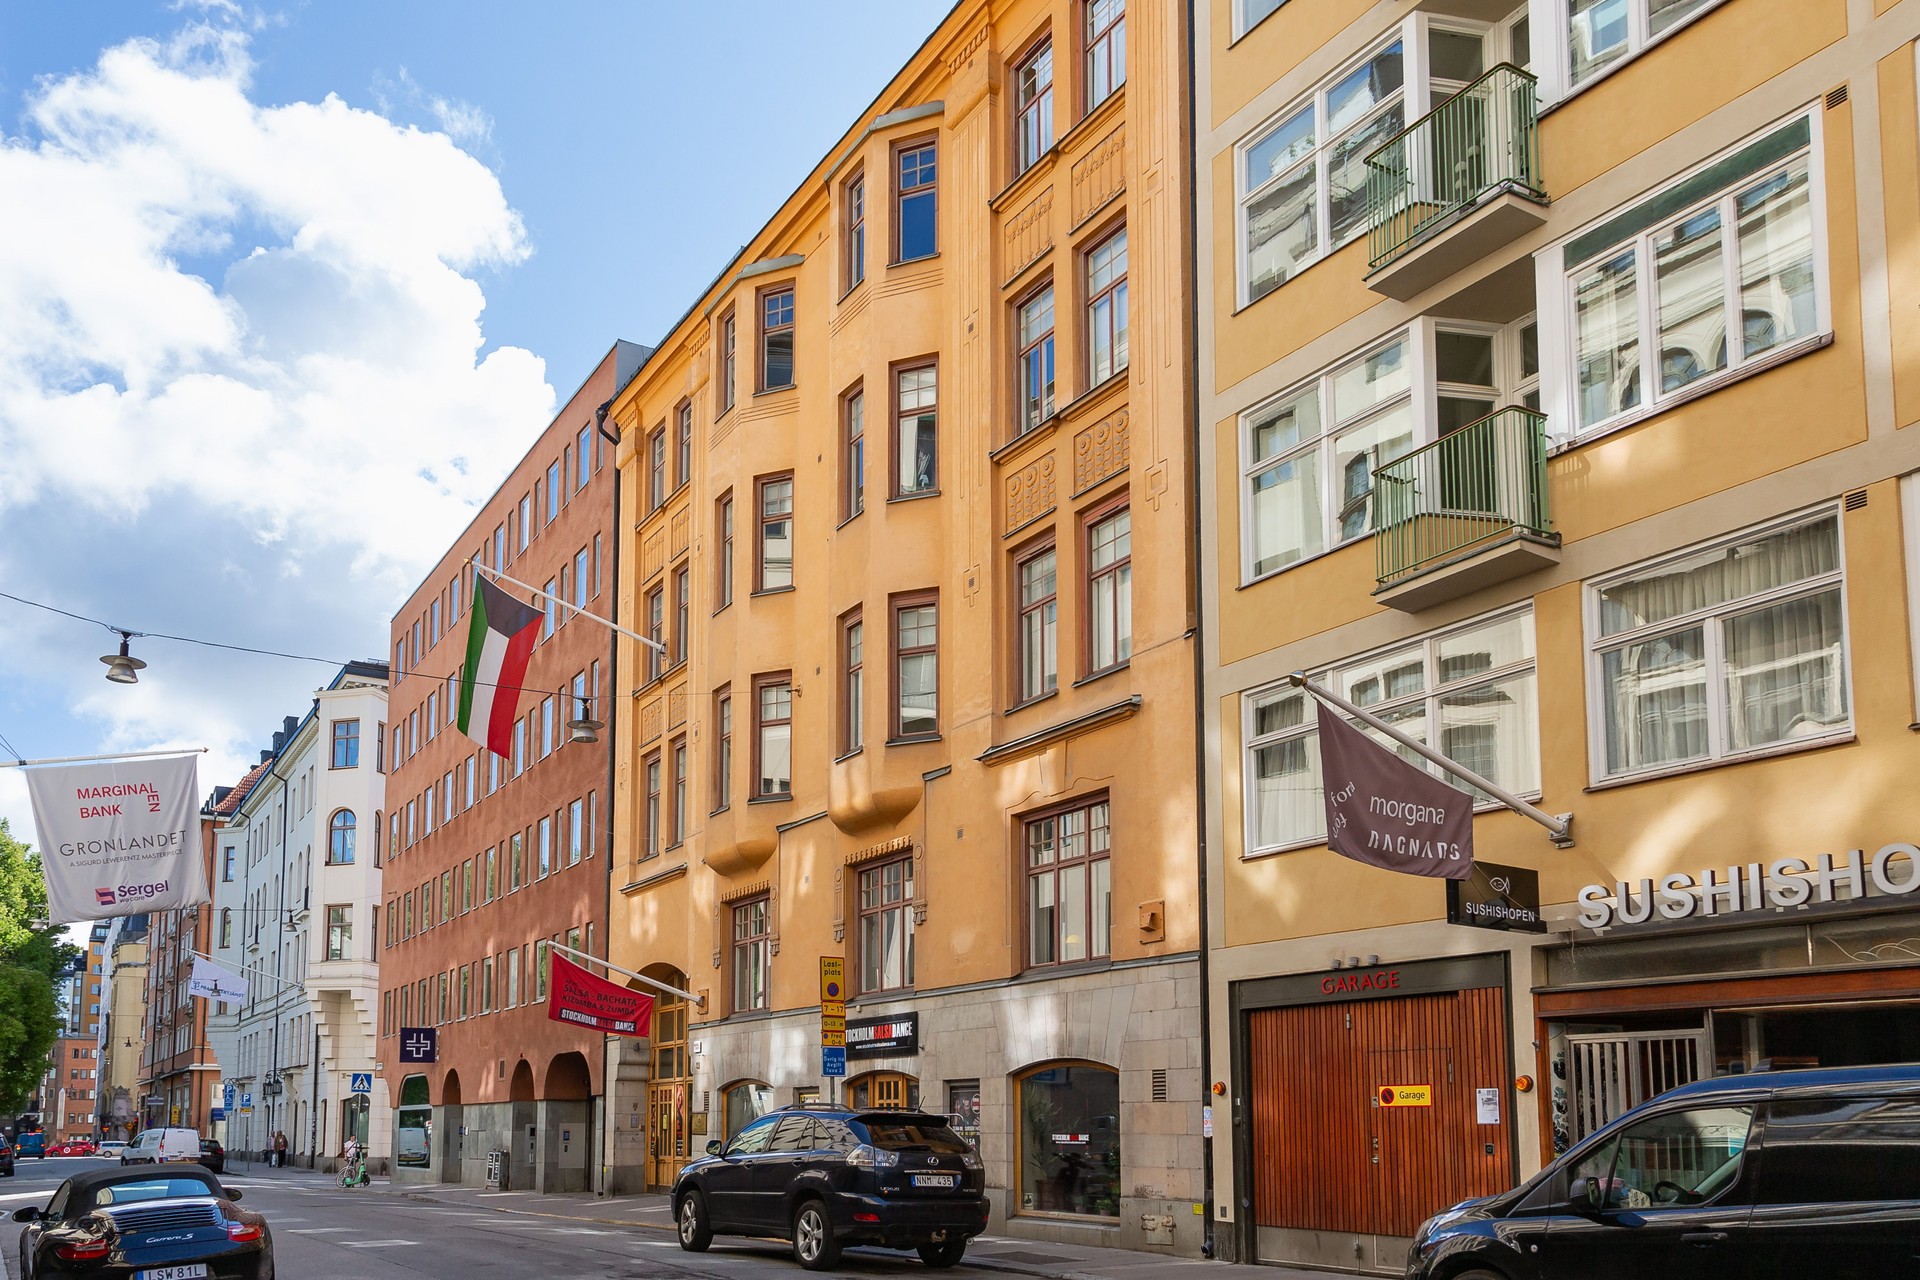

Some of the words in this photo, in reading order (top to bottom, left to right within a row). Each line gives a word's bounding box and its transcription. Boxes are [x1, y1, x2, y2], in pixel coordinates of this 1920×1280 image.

[80, 804, 122, 818] BANK
[1369, 795, 1445, 826] morgana
[60, 830, 186, 856] GRÖNLANDET
[76, 859, 101, 867] SIGURD
[103, 854, 140, 864] LEWERENTZ
[142, 849, 183, 860] MASTERPIECE
[118, 880, 169, 897] Sergel
[1577, 842, 1920, 929] SUSHISHO
[1466, 902, 1535, 922] SUSHISHOPEN
[1321, 971, 1399, 994] GARAGE
[564, 984, 589, 997] SALSA
[596, 994, 637, 1007] BACHATA
[606, 1006, 635, 1016] ZUMBA
[243, 1094, 250, 1102] P
[1399, 1091, 1425, 1100] Garage
[916, 1176, 932, 1184] NNM
[937, 1177, 952, 1186] 435
[146, 1235, 181, 1243] Carrera
[177, 1265, 201, 1278] 81L
